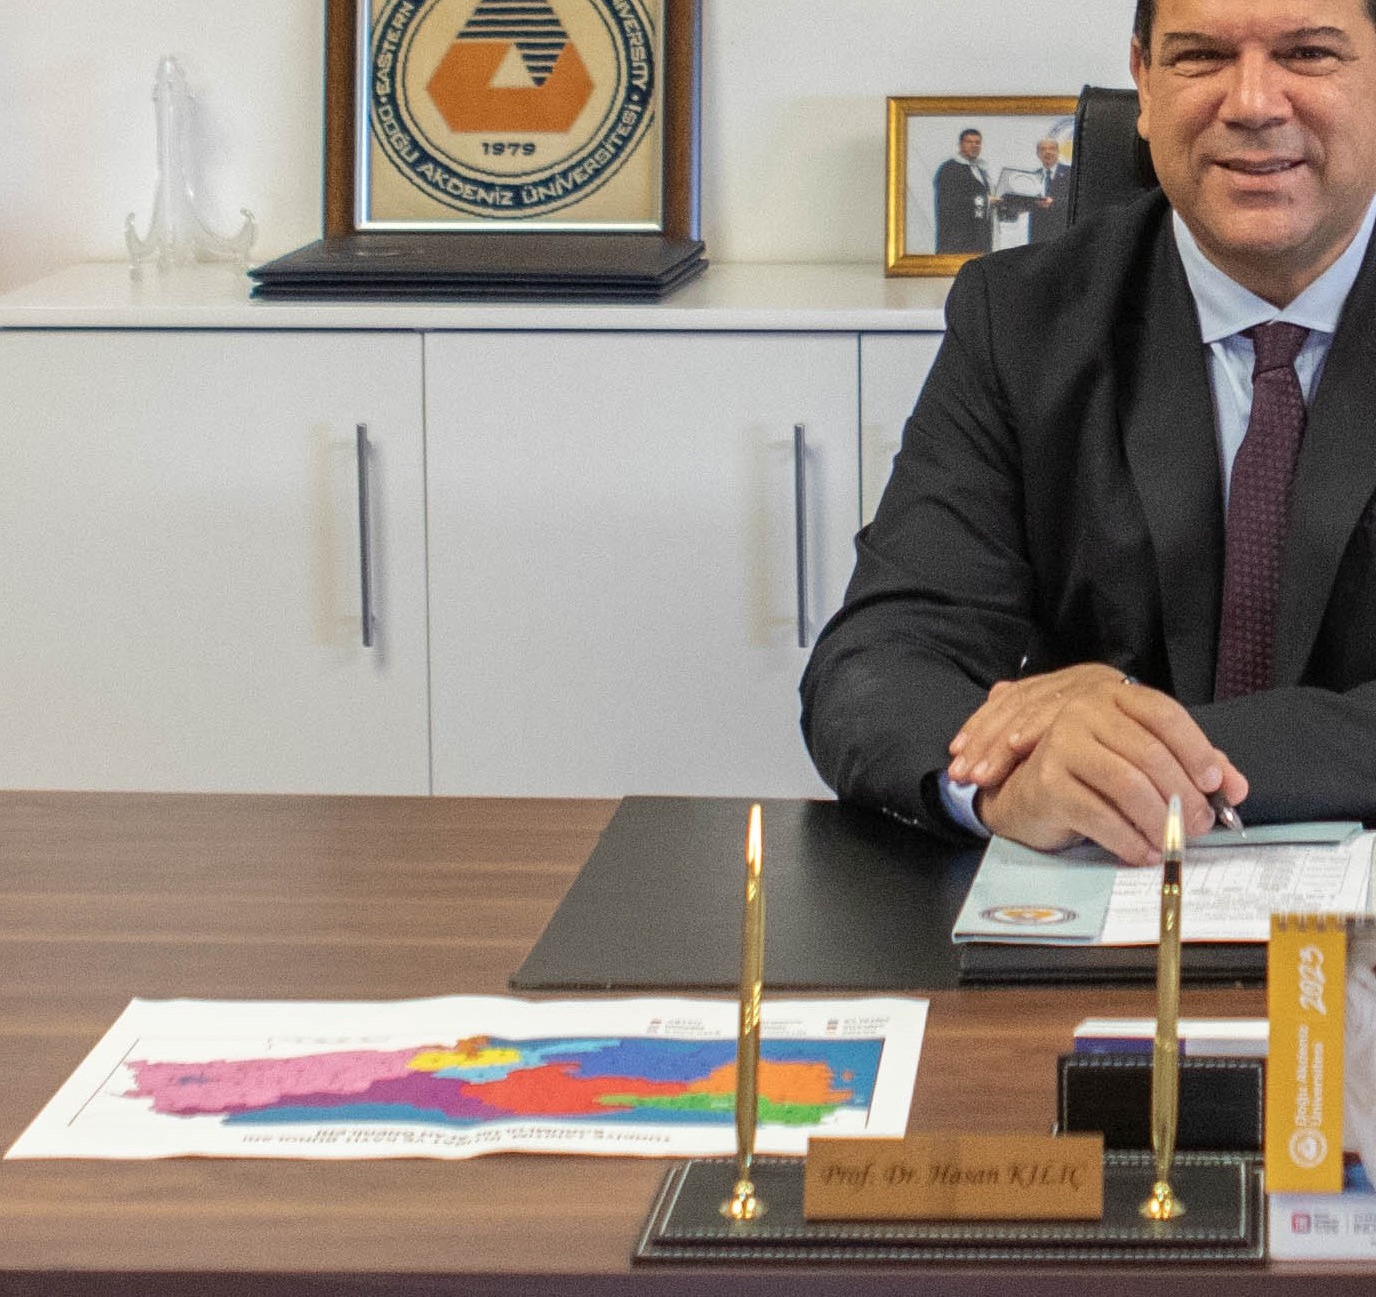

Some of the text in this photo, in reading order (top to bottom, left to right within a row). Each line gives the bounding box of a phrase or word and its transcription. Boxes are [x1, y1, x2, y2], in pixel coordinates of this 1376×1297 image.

[376, 1, 416, 95] EASTERN
[377, 105, 420, 165] DOĞU
[419, 162, 514, 206] AKDENİZ
[482, 142, 537, 156] 1979
[929, 1163, 998, 1185] Hasan
